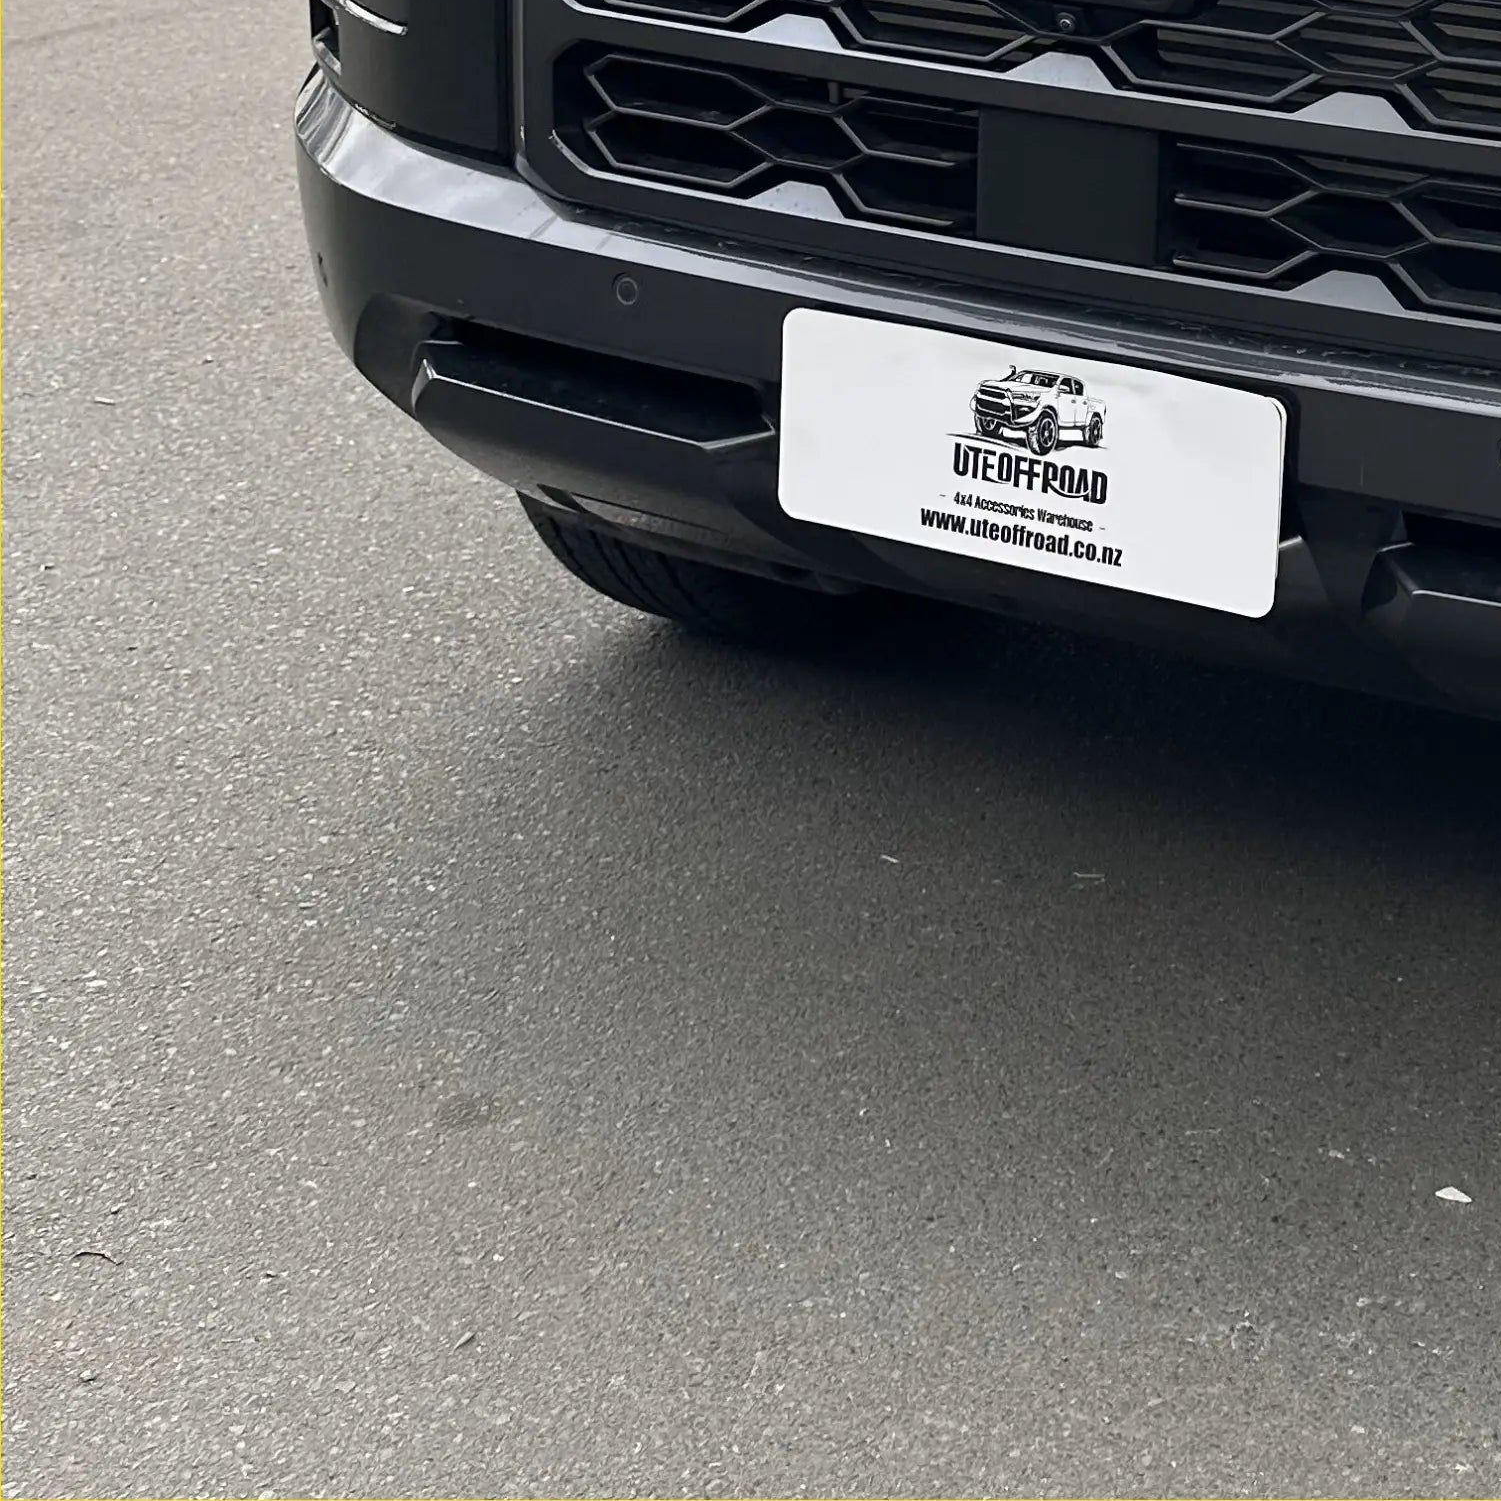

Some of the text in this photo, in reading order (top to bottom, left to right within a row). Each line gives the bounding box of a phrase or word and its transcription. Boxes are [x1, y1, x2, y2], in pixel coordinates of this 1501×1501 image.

[920, 507, 1124, 567] www.uteoffroad.co.nz
[953, 491, 1094, 533] 4x4 Accessories Warehouse
